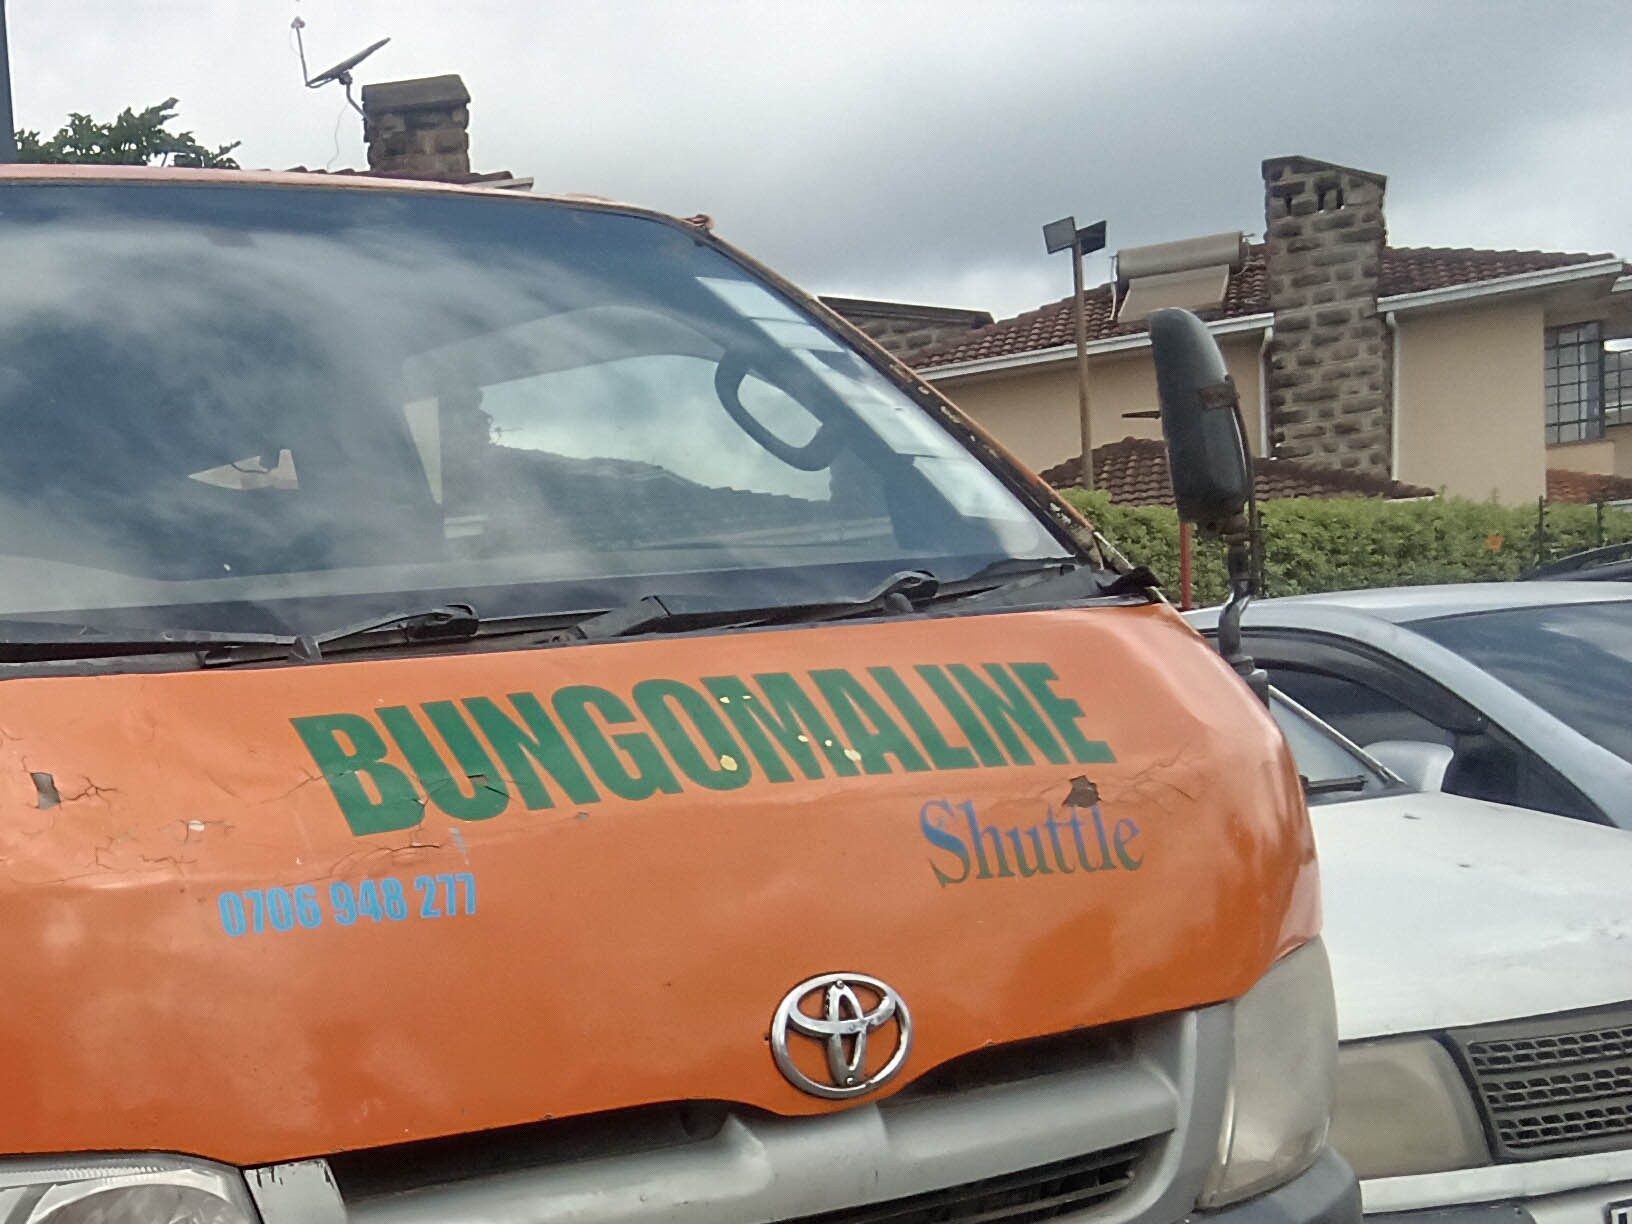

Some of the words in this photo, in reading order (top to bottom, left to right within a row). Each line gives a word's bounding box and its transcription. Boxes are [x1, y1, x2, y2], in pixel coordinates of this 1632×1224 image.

[291, 661, 1117, 838] BUNGOMALINE
[919, 797, 1146, 889] Shuttle
[218, 884, 323, 938] 0706
[329, 877, 409, 926] 948
[414, 872, 478, 919] 277
